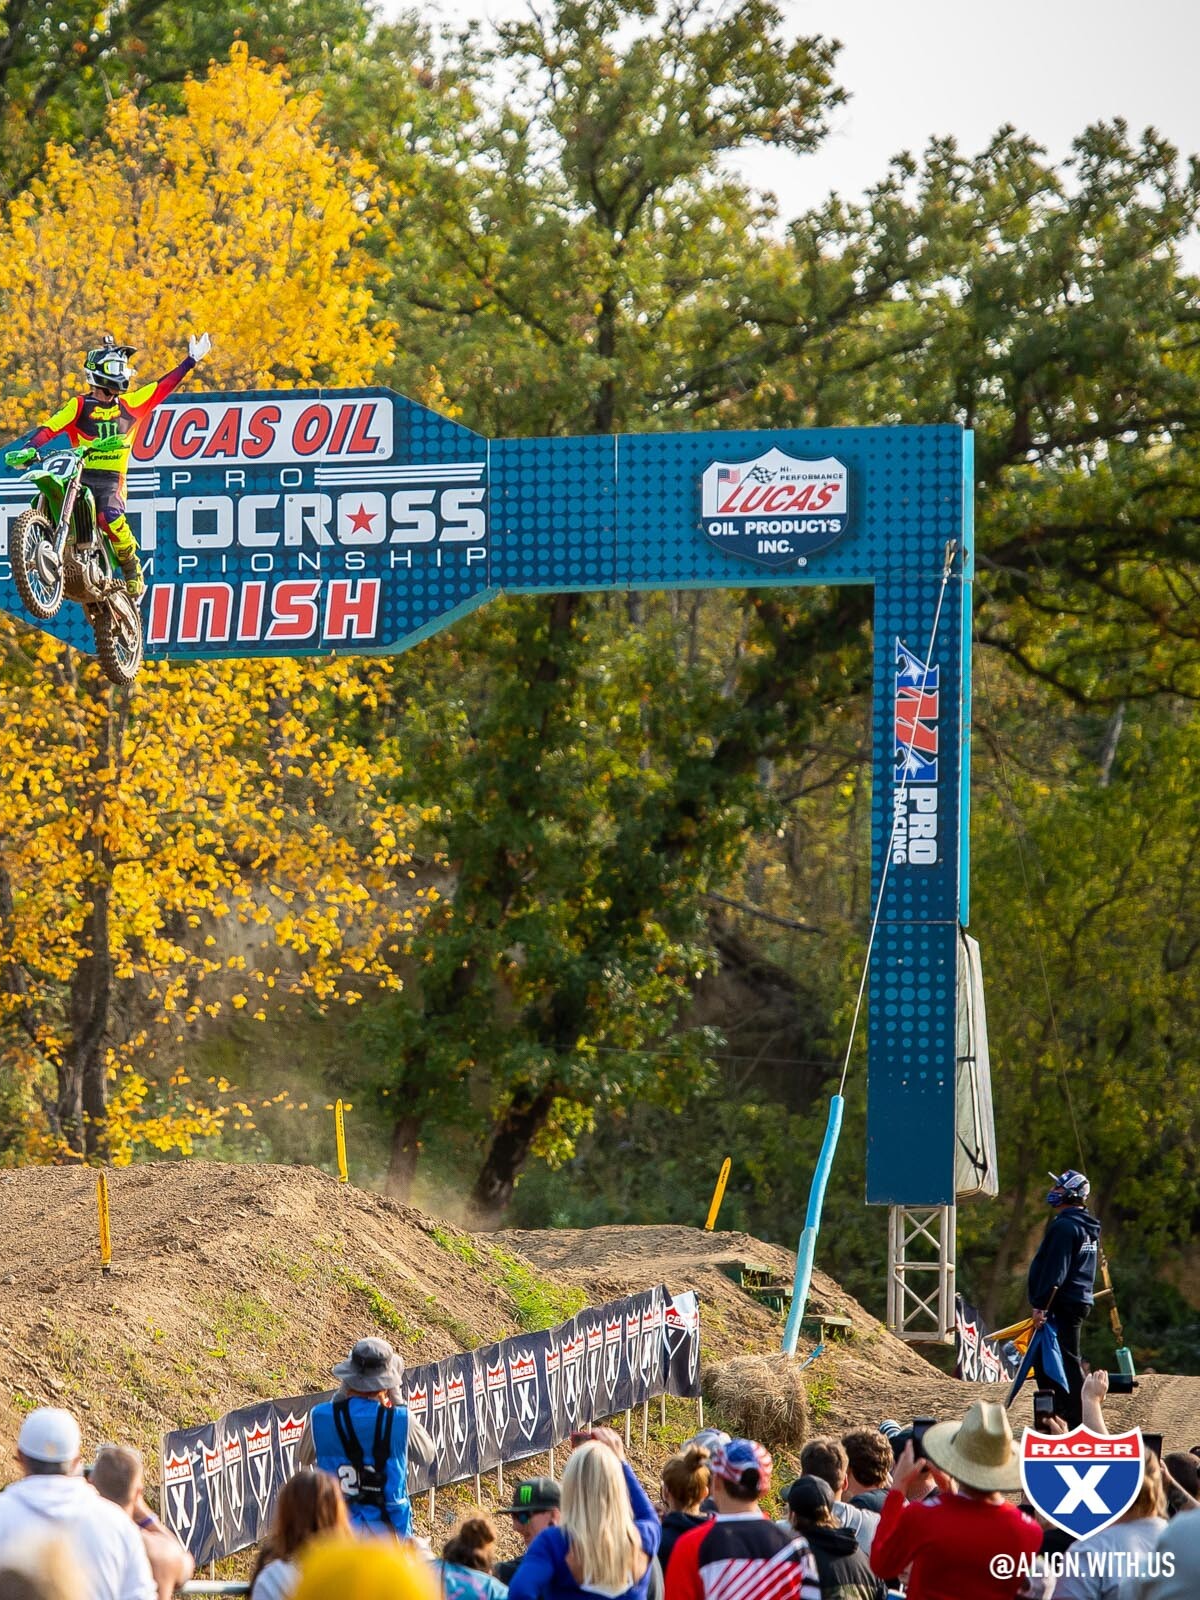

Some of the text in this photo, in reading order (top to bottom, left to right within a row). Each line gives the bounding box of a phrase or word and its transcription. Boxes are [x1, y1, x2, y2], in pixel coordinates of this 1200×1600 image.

[131, 403, 381, 462] UCAS OIL
[171, 468, 303, 490] PRO
[780, 472, 844, 481] PERFORMANCE
[718, 483, 840, 513] LUCAS
[708, 519, 841, 536] OIL PRODUCTS
[757, 540, 794, 554] INC.
[136, 578, 381, 644] INISH
[893, 788, 908, 864] RACING
[908, 788, 938, 865] PRO
[511, 1364, 535, 1377] RACER
[517, 1382, 535, 1421] X
[451, 1404, 464, 1443] X
[229, 1464, 241, 1510] X
[254, 1454, 268, 1499] X
[170, 1484, 191, 1530] X
